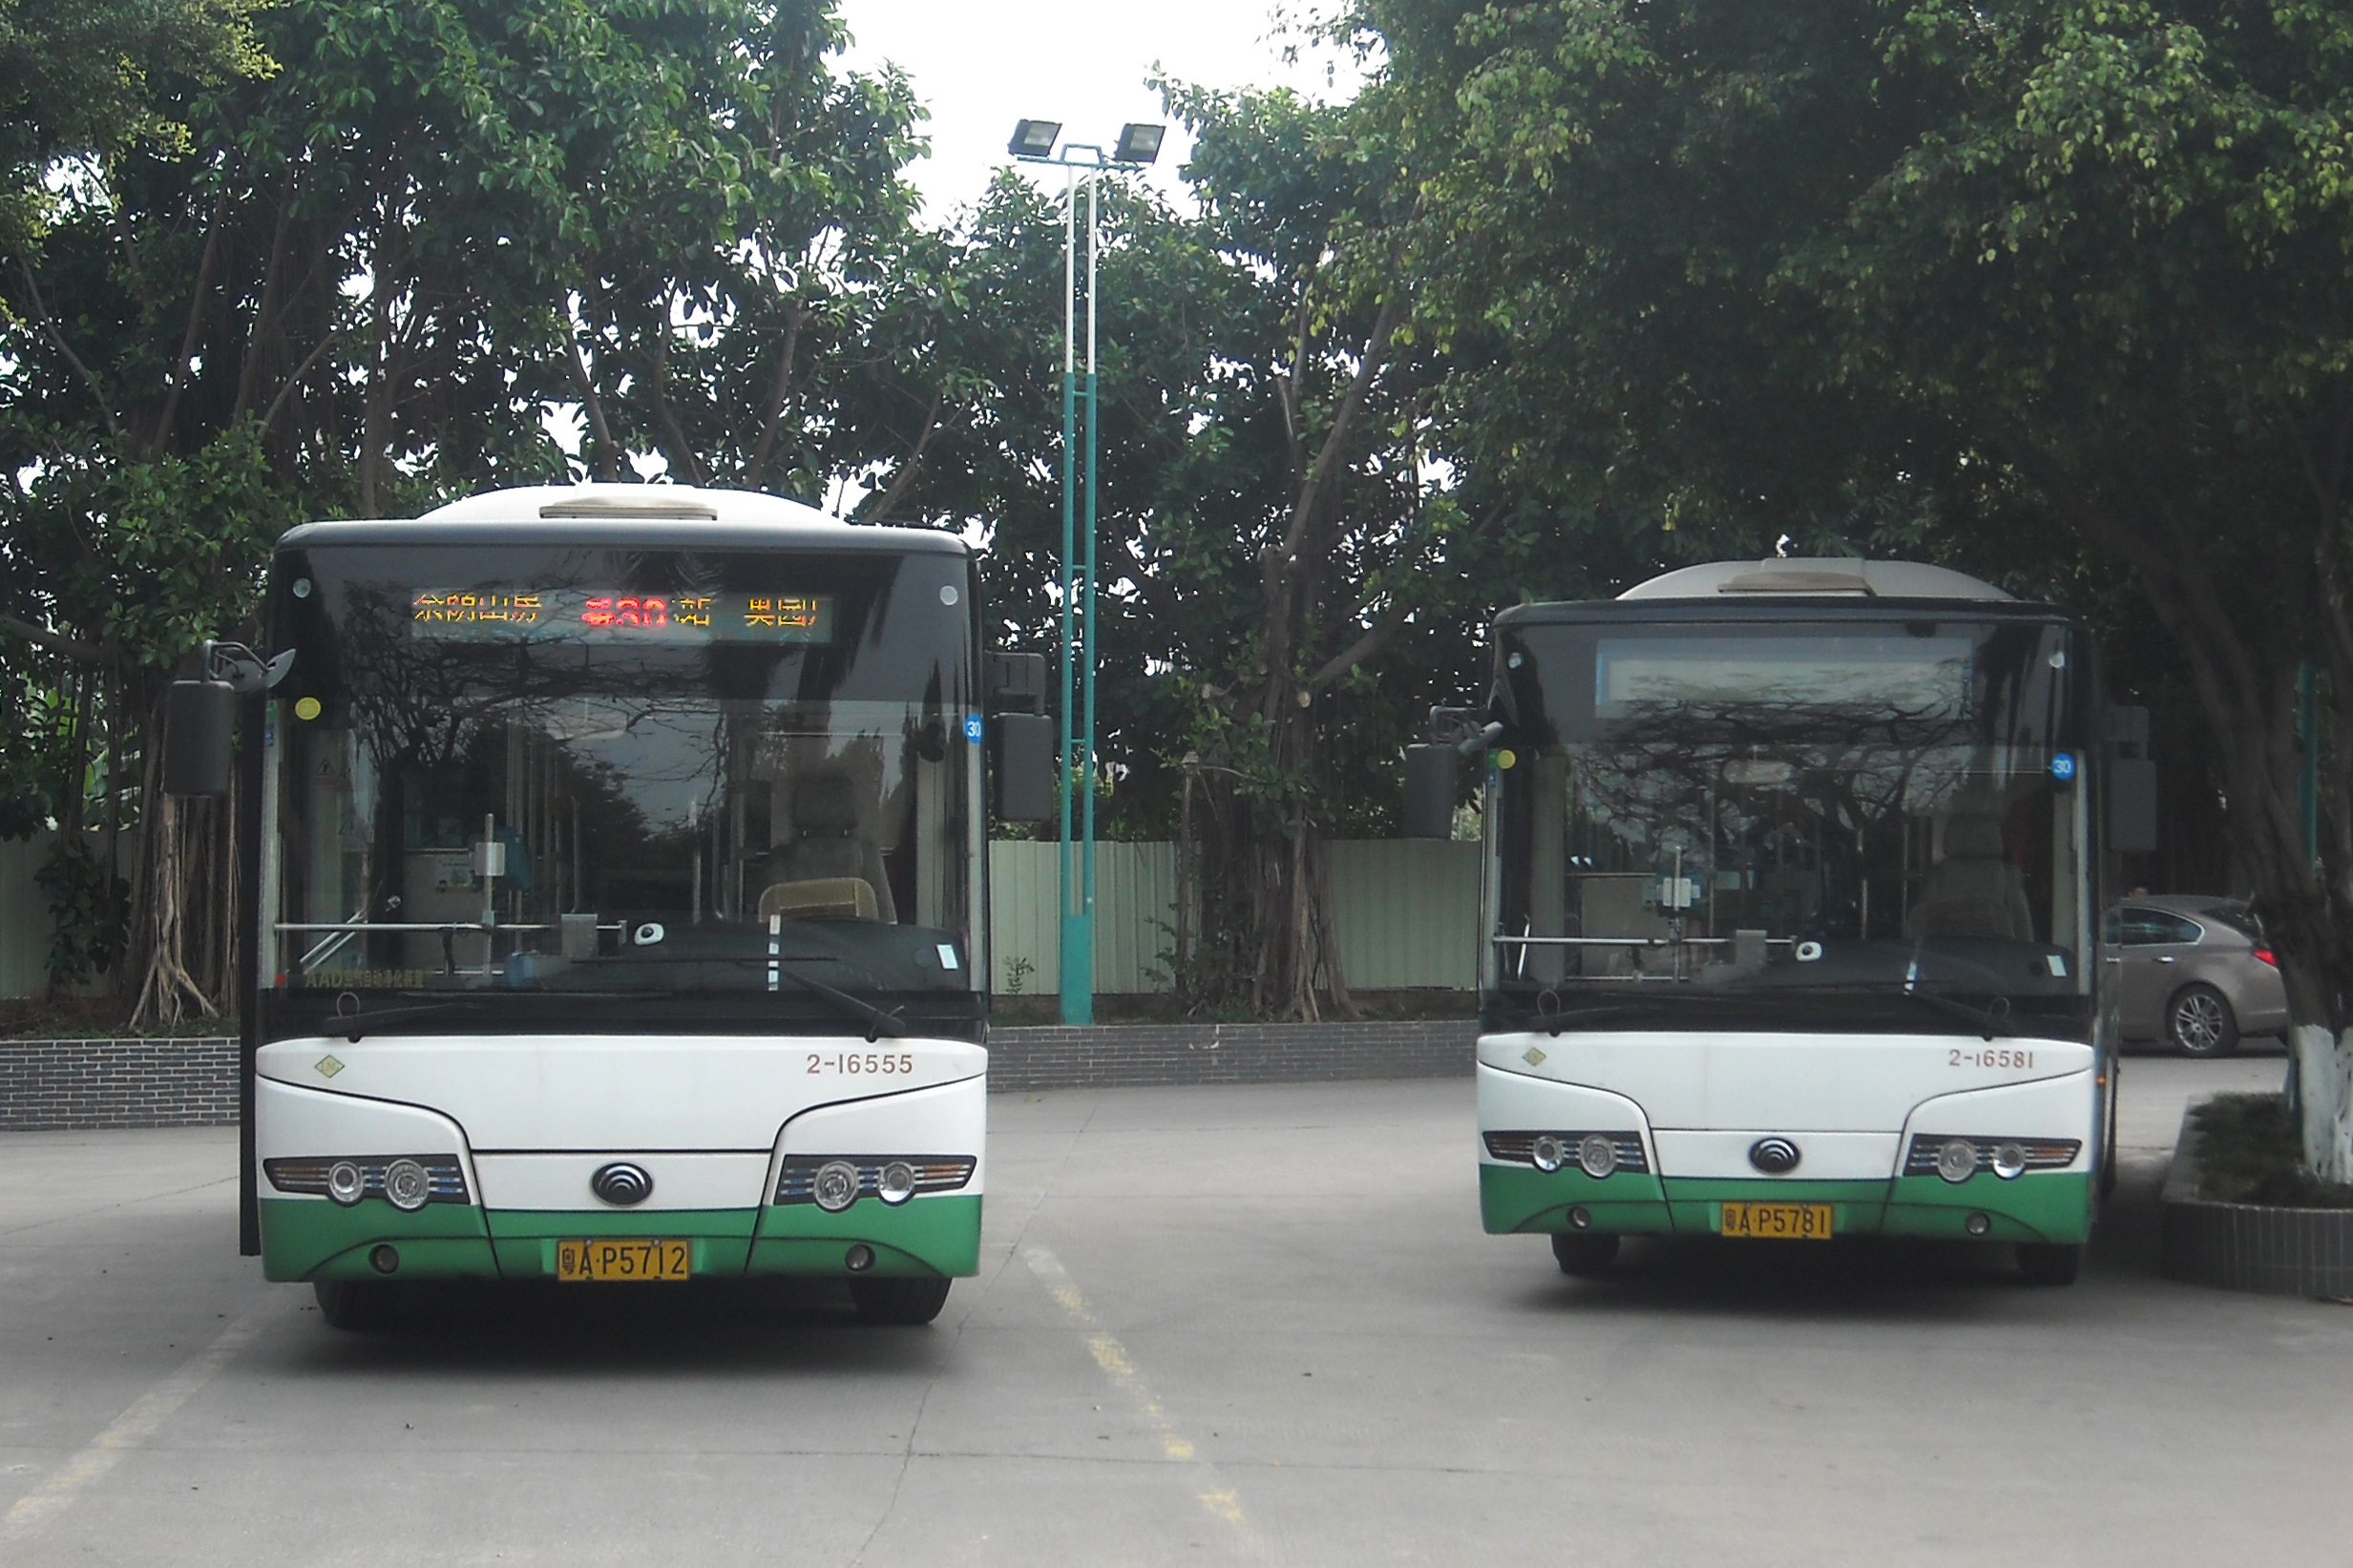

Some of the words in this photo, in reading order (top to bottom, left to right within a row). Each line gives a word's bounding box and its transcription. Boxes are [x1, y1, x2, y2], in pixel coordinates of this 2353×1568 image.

[671, 597, 711, 626] 站
[744, 598, 817, 627] 奥园
[967, 721, 982, 738] 30
[2053, 760, 2071, 774] 30
[807, 1054, 913, 1075] 2-16555
[1948, 1049, 2033, 1069] 2-16581
